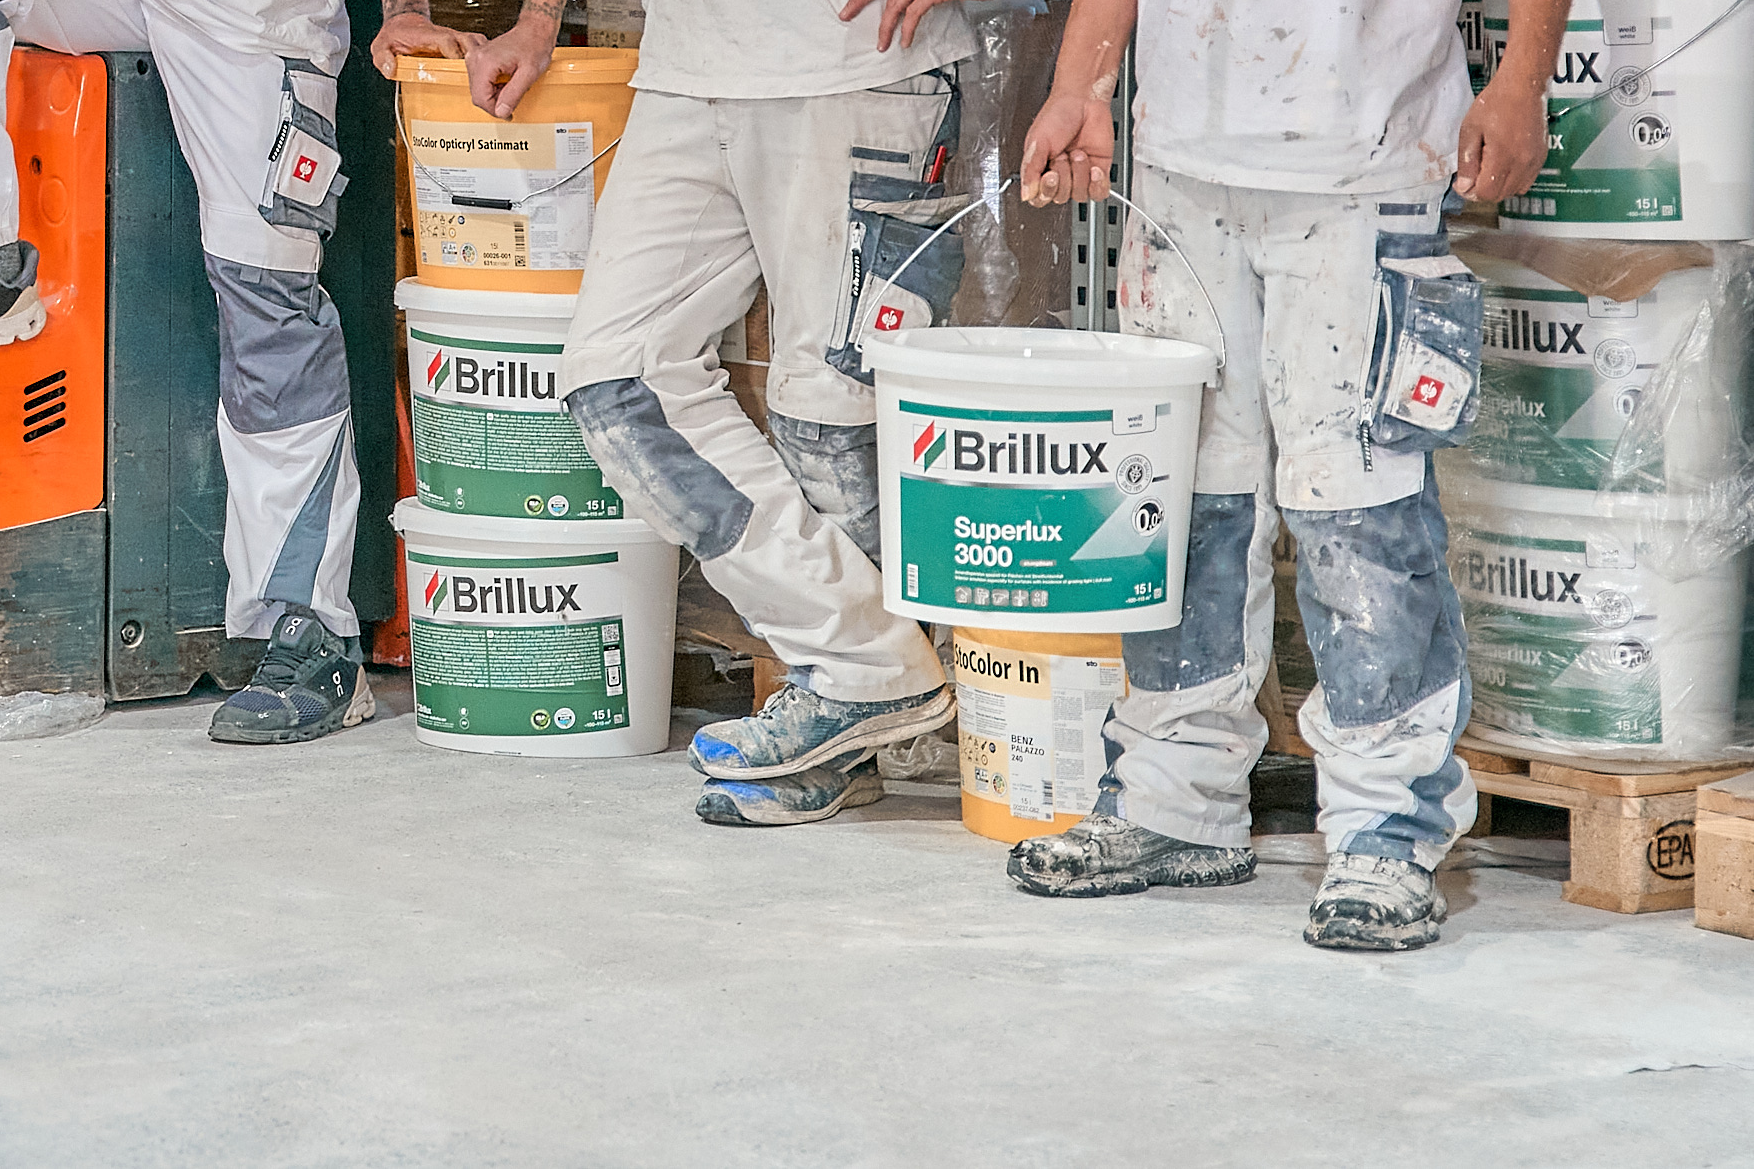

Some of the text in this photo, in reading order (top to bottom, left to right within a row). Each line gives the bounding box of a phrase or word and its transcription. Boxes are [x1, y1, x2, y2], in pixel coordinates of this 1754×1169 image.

[1618, 25, 1637, 33] weiß
[413, 136, 529, 152] StoColor Opticryl Satinmatt
[1635, 198, 1651, 209] 15
[1483, 308, 1586, 355] rillux
[456, 356, 560, 400] Brillu
[954, 430, 1109, 475] Brillux
[586, 500, 599, 510] 15
[954, 515, 1063, 544] Superlux
[954, 544, 1013, 568] 3000
[1469, 550, 1583, 604] Brillux
[452, 576, 582, 615] Brillux
[1134, 583, 1146, 595] 15
[955, 644, 1040, 684] StoColor In
[593, 710, 605, 720] 15
[1011, 734, 1034, 746] BENZ
[1011, 744, 1045, 756] PALAZZO
[1011, 754, 1024, 763] 240
